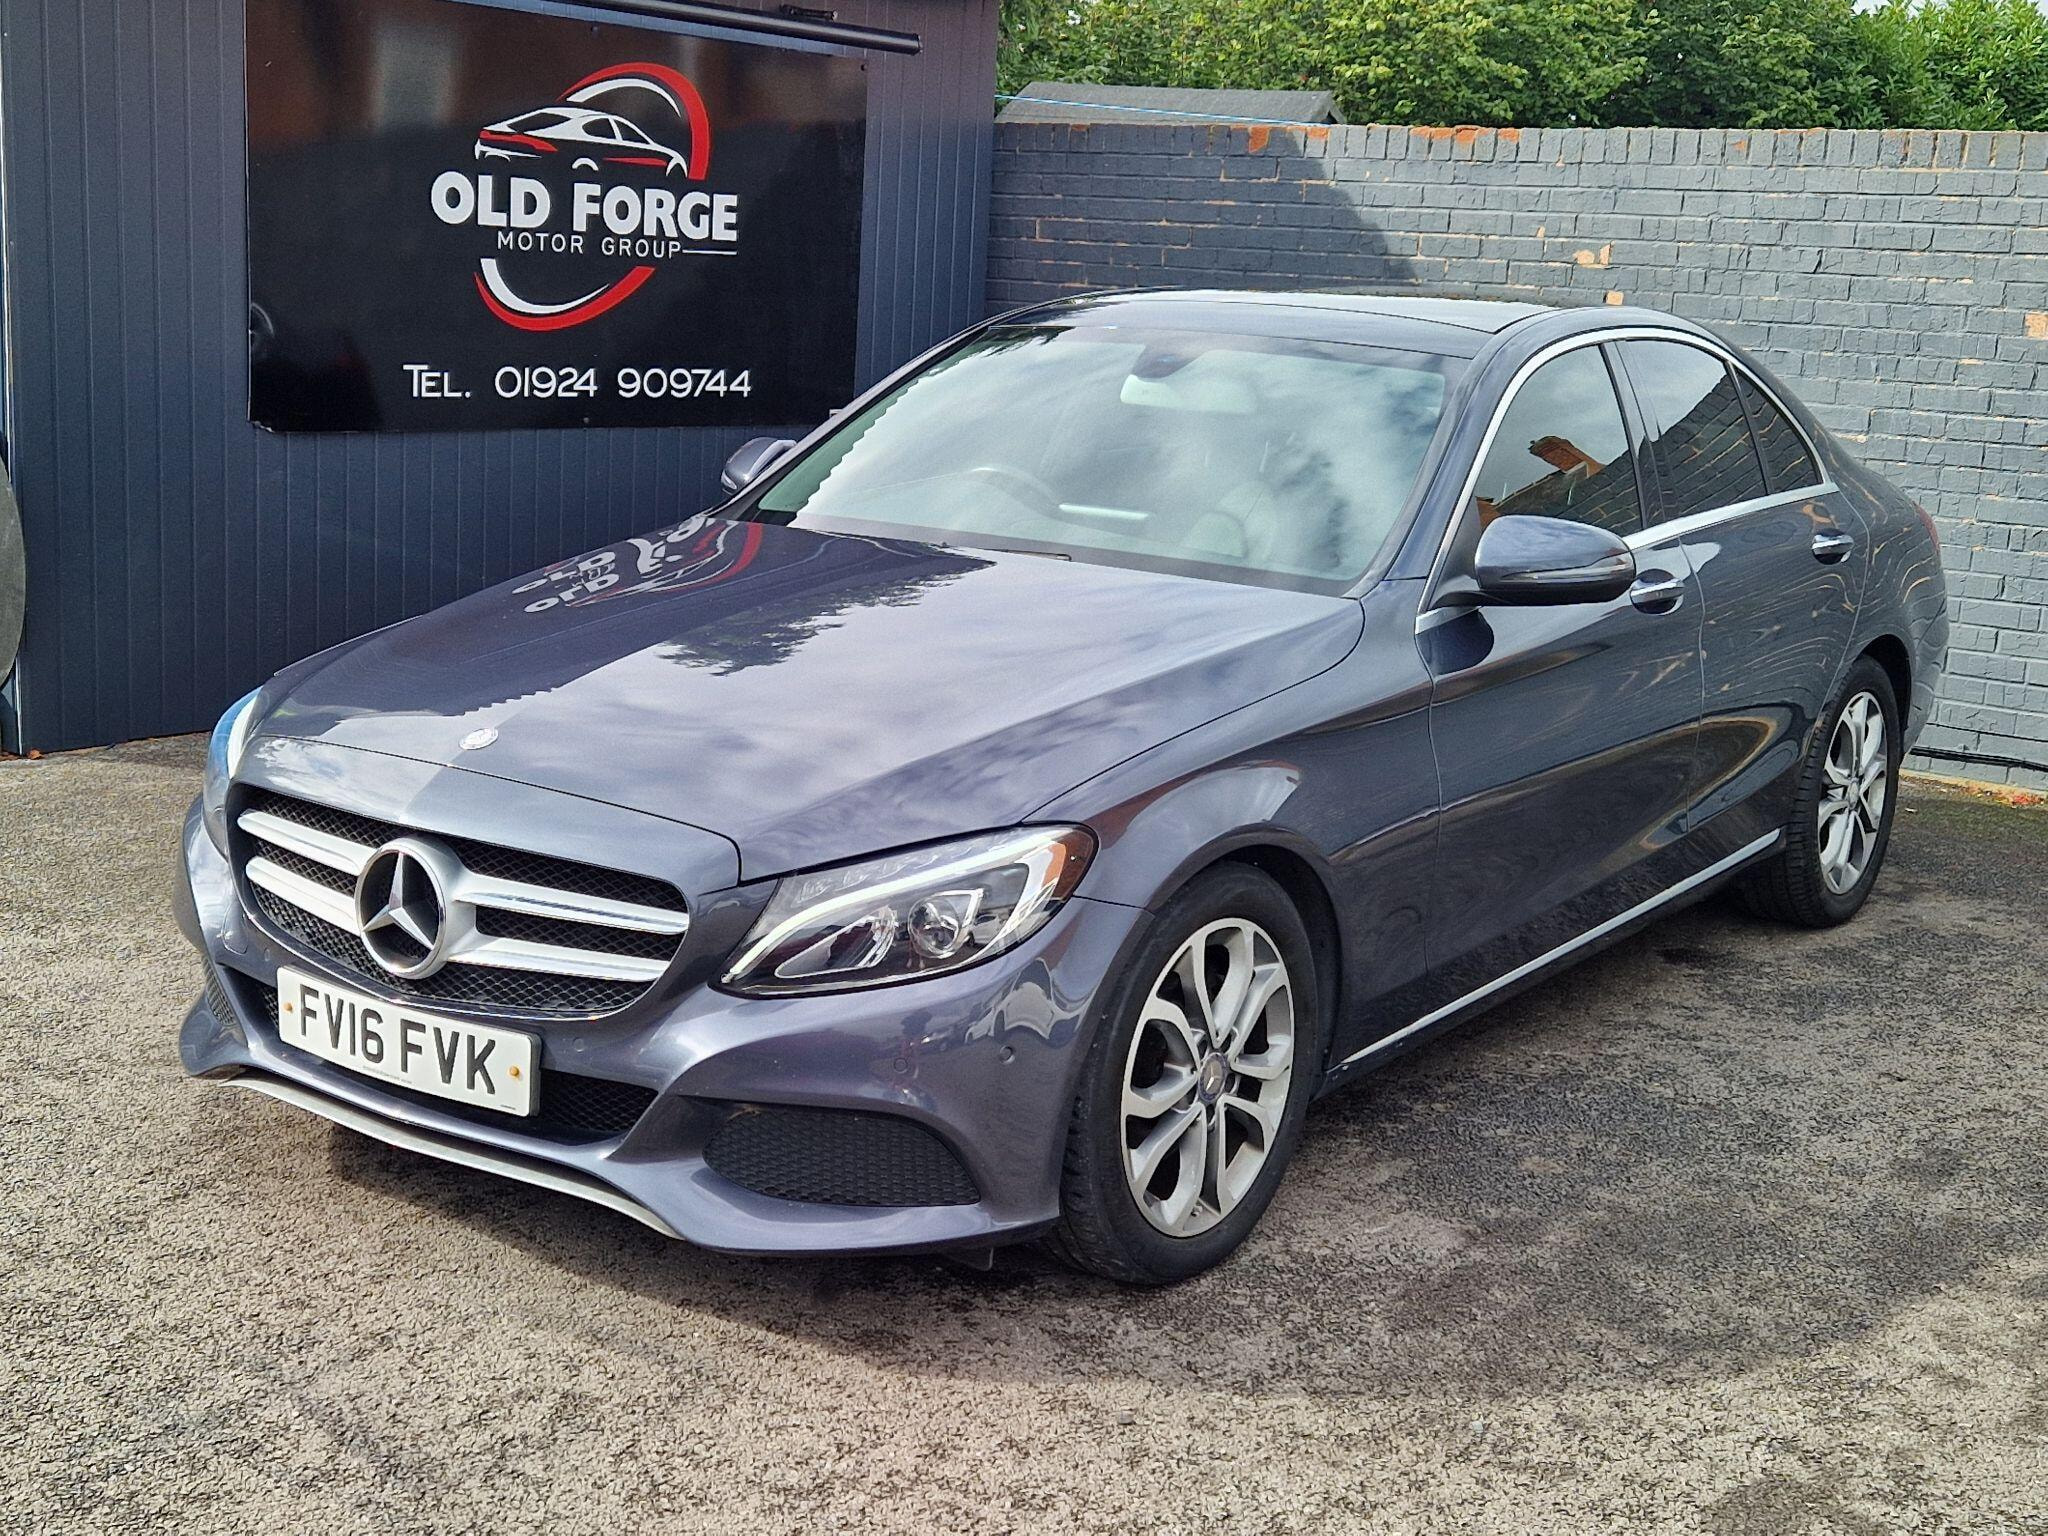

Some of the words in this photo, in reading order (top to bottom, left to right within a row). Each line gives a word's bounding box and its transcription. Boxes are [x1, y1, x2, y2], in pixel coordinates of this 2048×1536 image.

[430, 170, 551, 229] OLD
[572, 182, 738, 242] FORGE
[497, 230, 584, 254] MOTOR
[600, 236, 682, 260] GROUP
[402, 364, 472, 399] TEL.
[494, 366, 599, 399] 01924
[616, 367, 752, 399] 909744
[300, 983, 384, 1064] FV16
[400, 1018, 496, 1096] FVK
